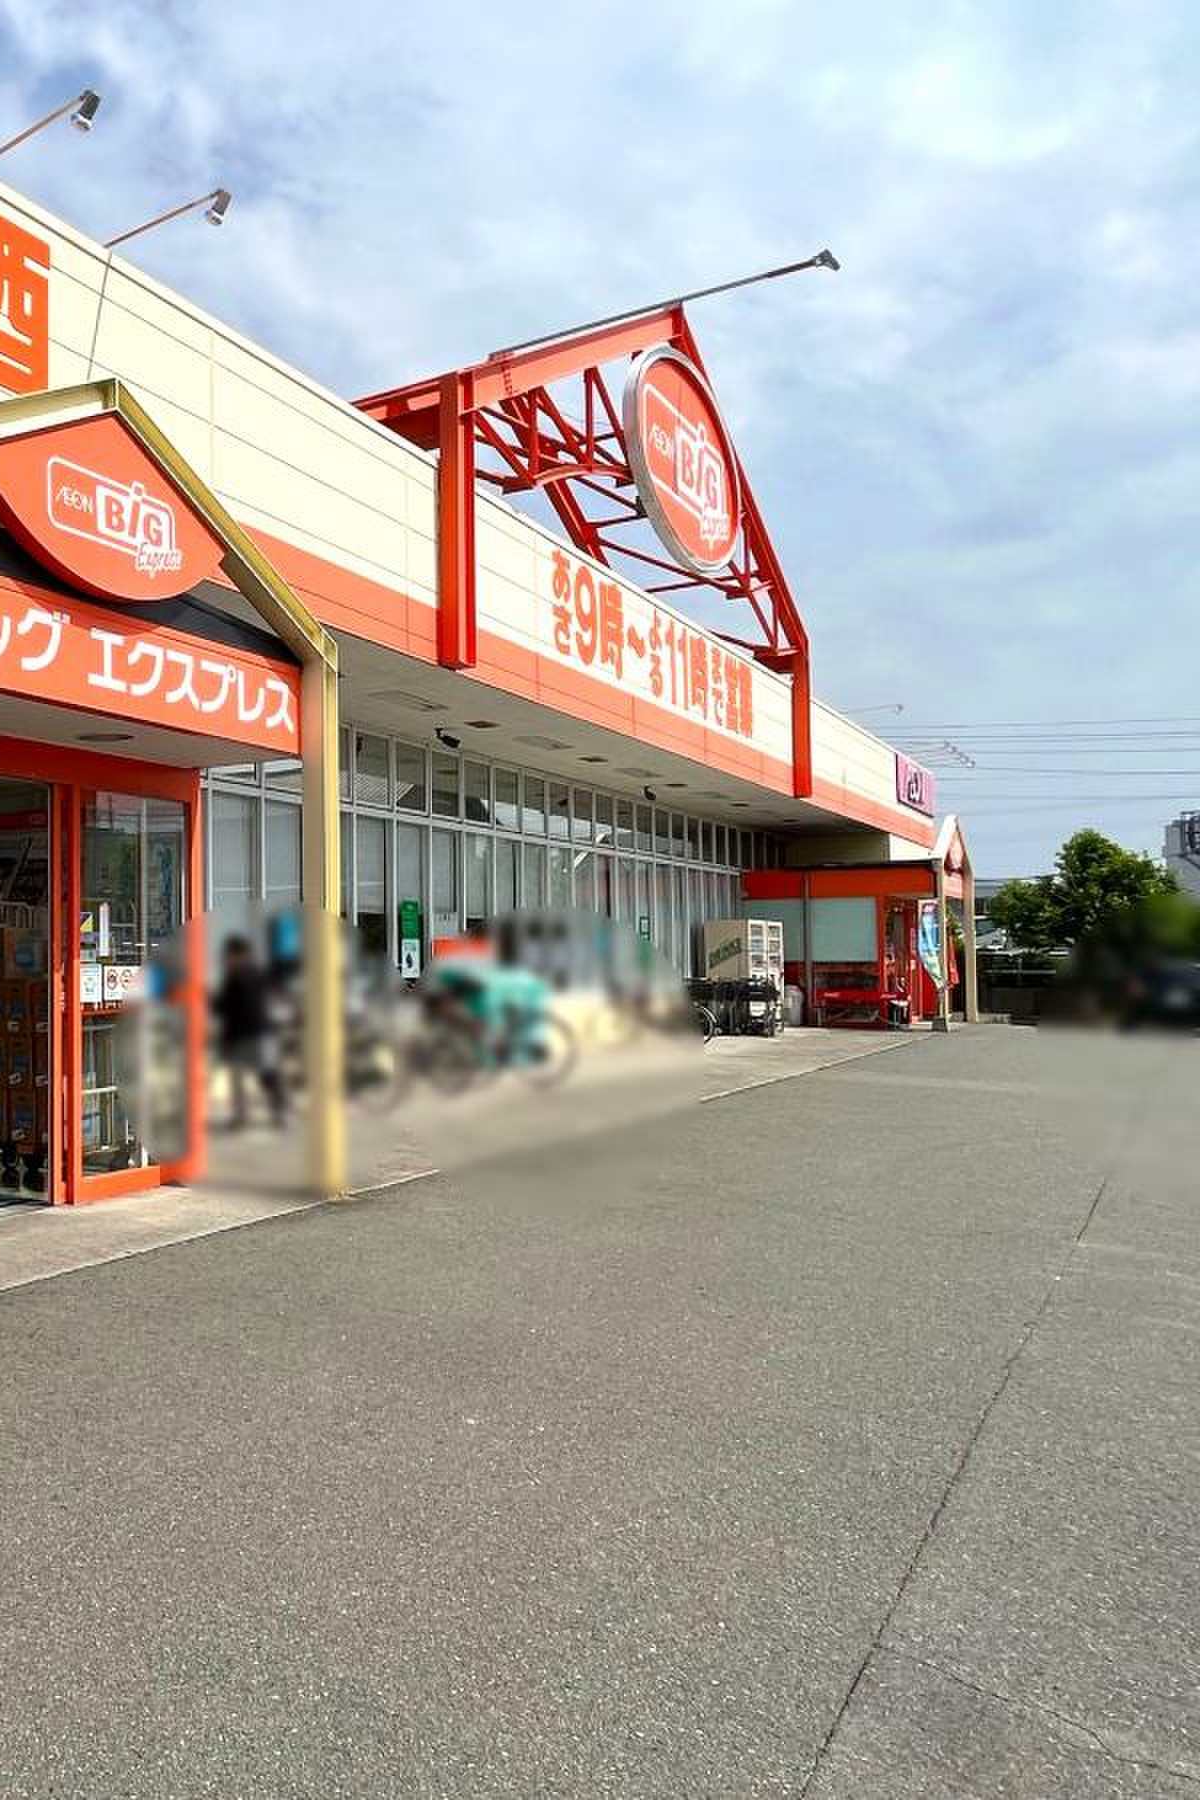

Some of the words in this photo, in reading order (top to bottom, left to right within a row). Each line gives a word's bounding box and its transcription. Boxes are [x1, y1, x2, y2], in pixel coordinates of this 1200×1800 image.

[101, 481, 167, 549] BIG
[87, 626, 295, 733] エクスプレス
